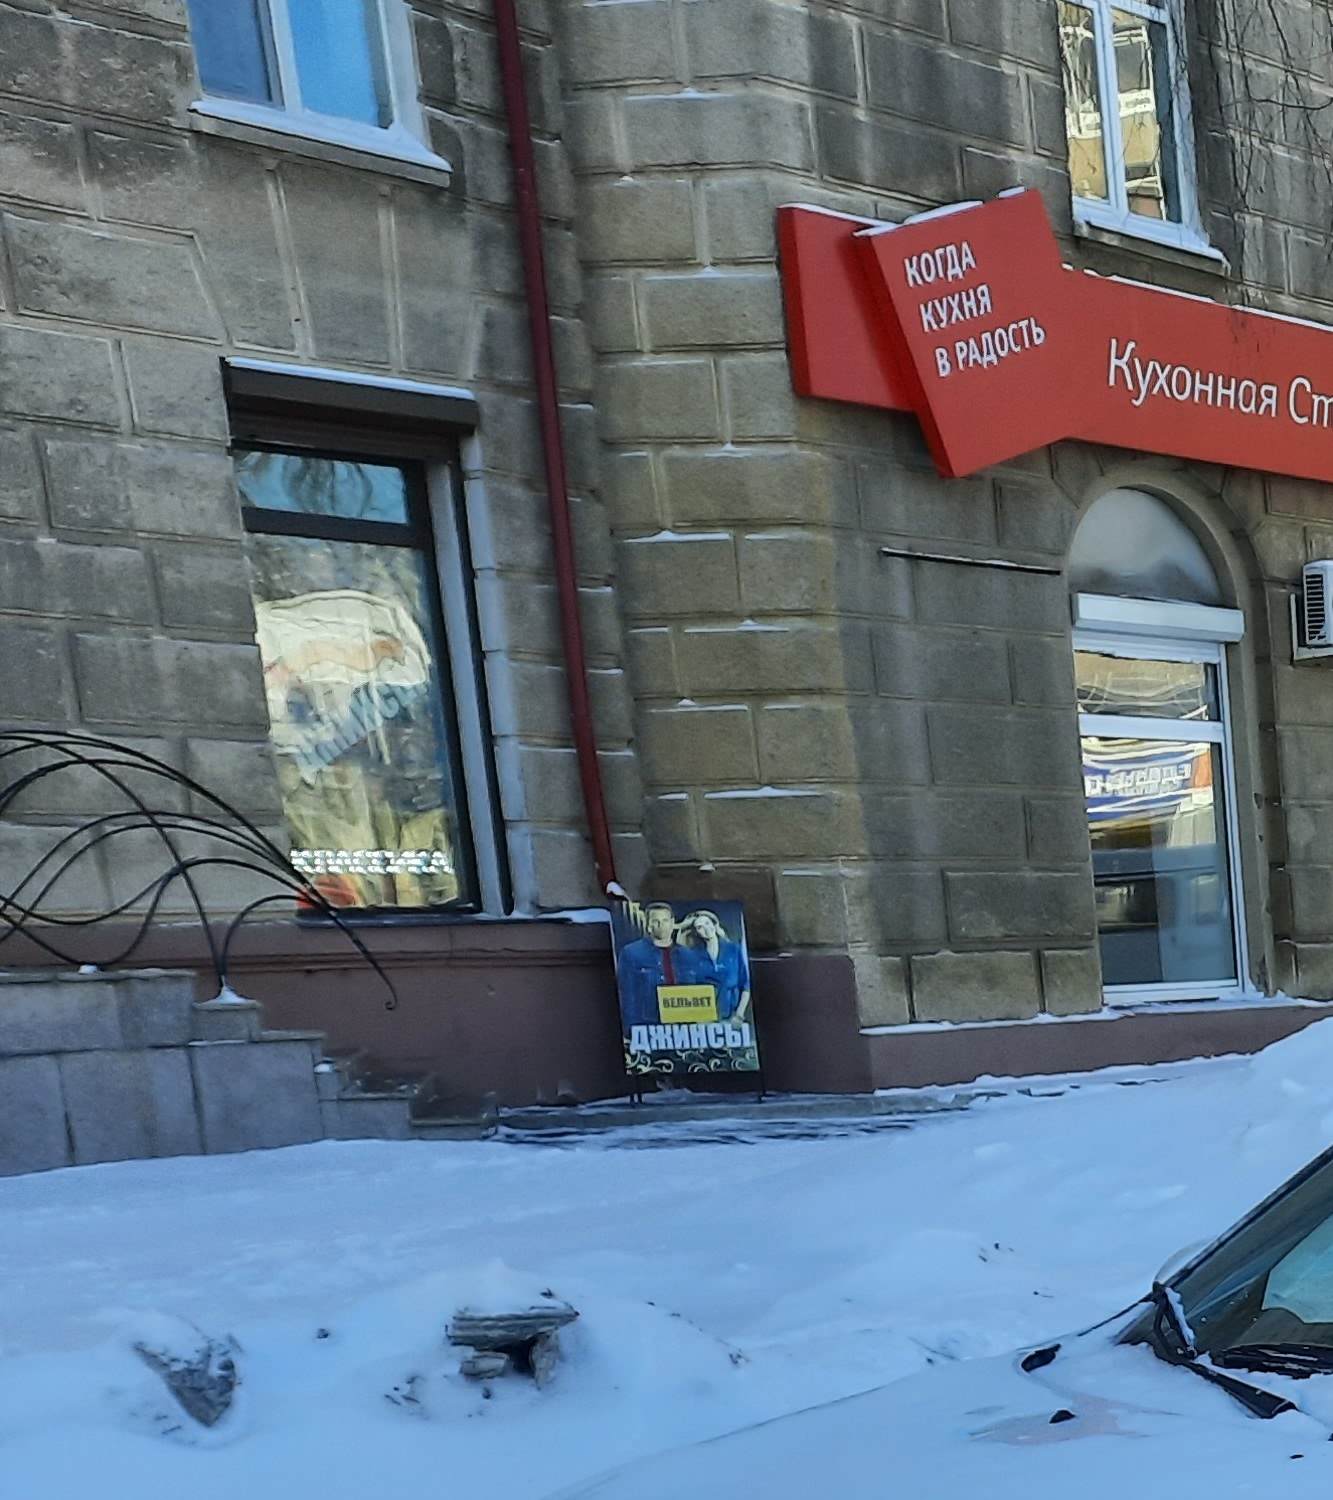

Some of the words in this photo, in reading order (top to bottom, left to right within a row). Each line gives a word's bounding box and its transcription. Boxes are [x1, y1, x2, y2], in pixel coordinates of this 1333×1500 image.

[904, 240, 977, 288] КОГДА
[919, 283, 993, 332] КУХНЯ
[935, 347, 952, 378] В
[954, 316, 1046, 372] РАДОСТЬ
[1107, 338, 1278, 419] Кухонная
[629, 1022, 751, 1054] ДЖИНСЫ
